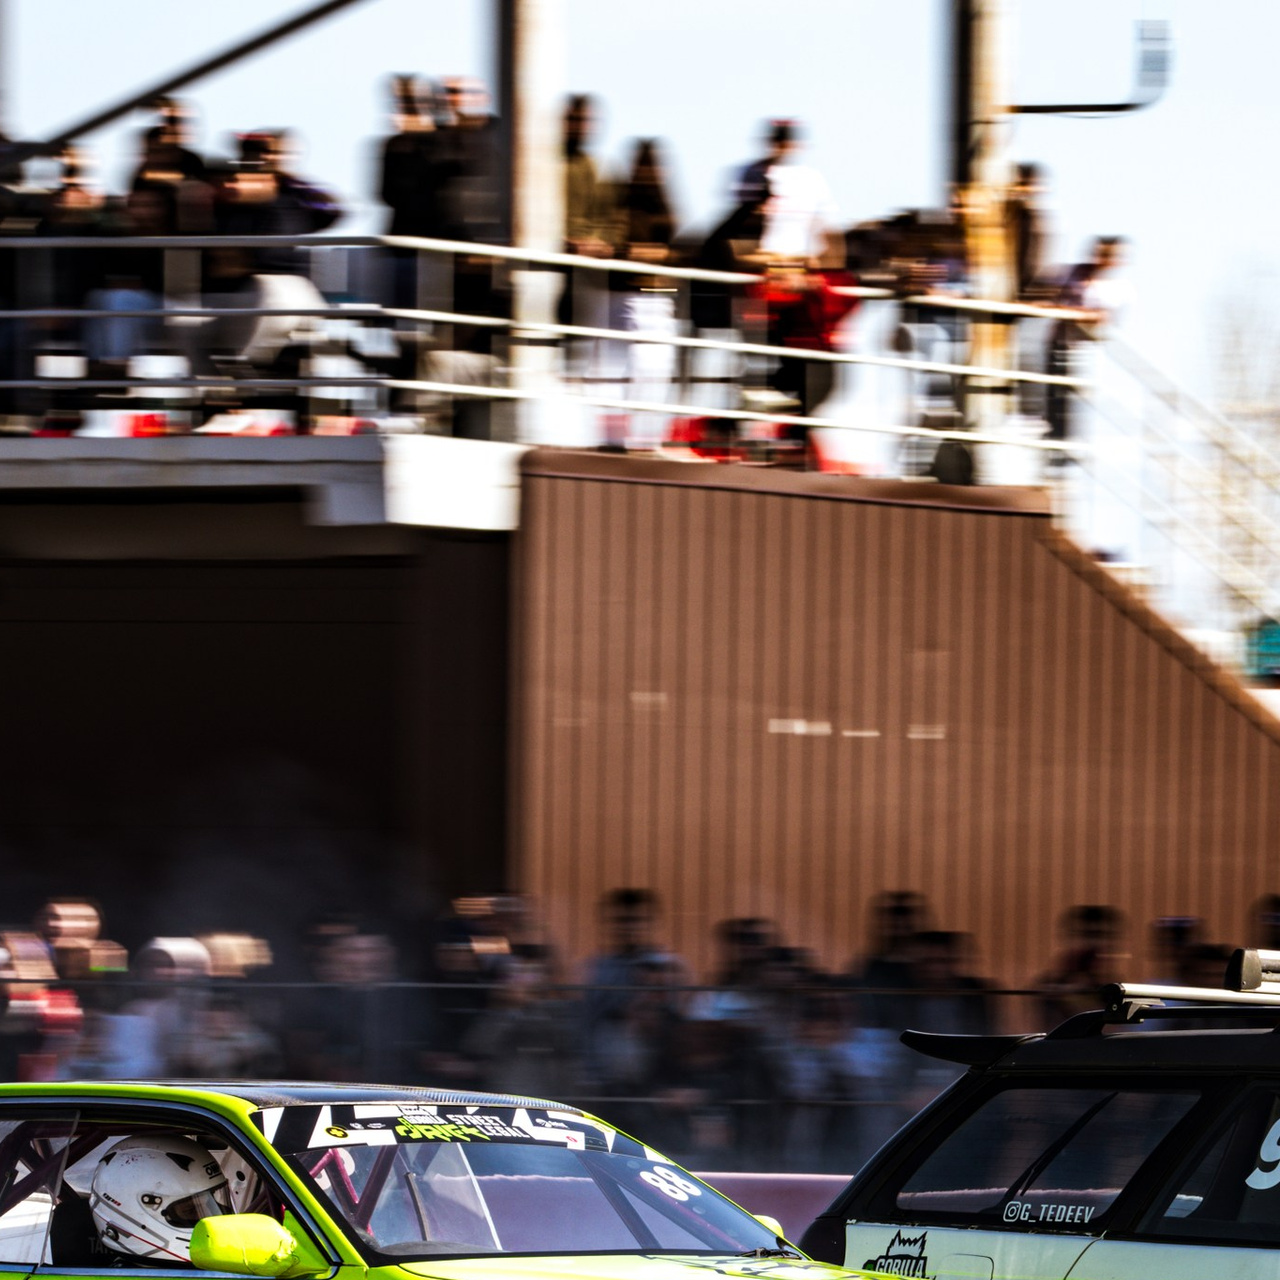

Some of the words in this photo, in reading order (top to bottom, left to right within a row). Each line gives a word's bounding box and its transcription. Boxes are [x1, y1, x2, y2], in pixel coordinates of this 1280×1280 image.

[446, 1114, 507, 1127] STREET
[476, 1125, 530, 1138] LEGAL
[640, 1166, 702, 1201] 88
[1020, 1204, 1095, 1223] G_TEDEEV
